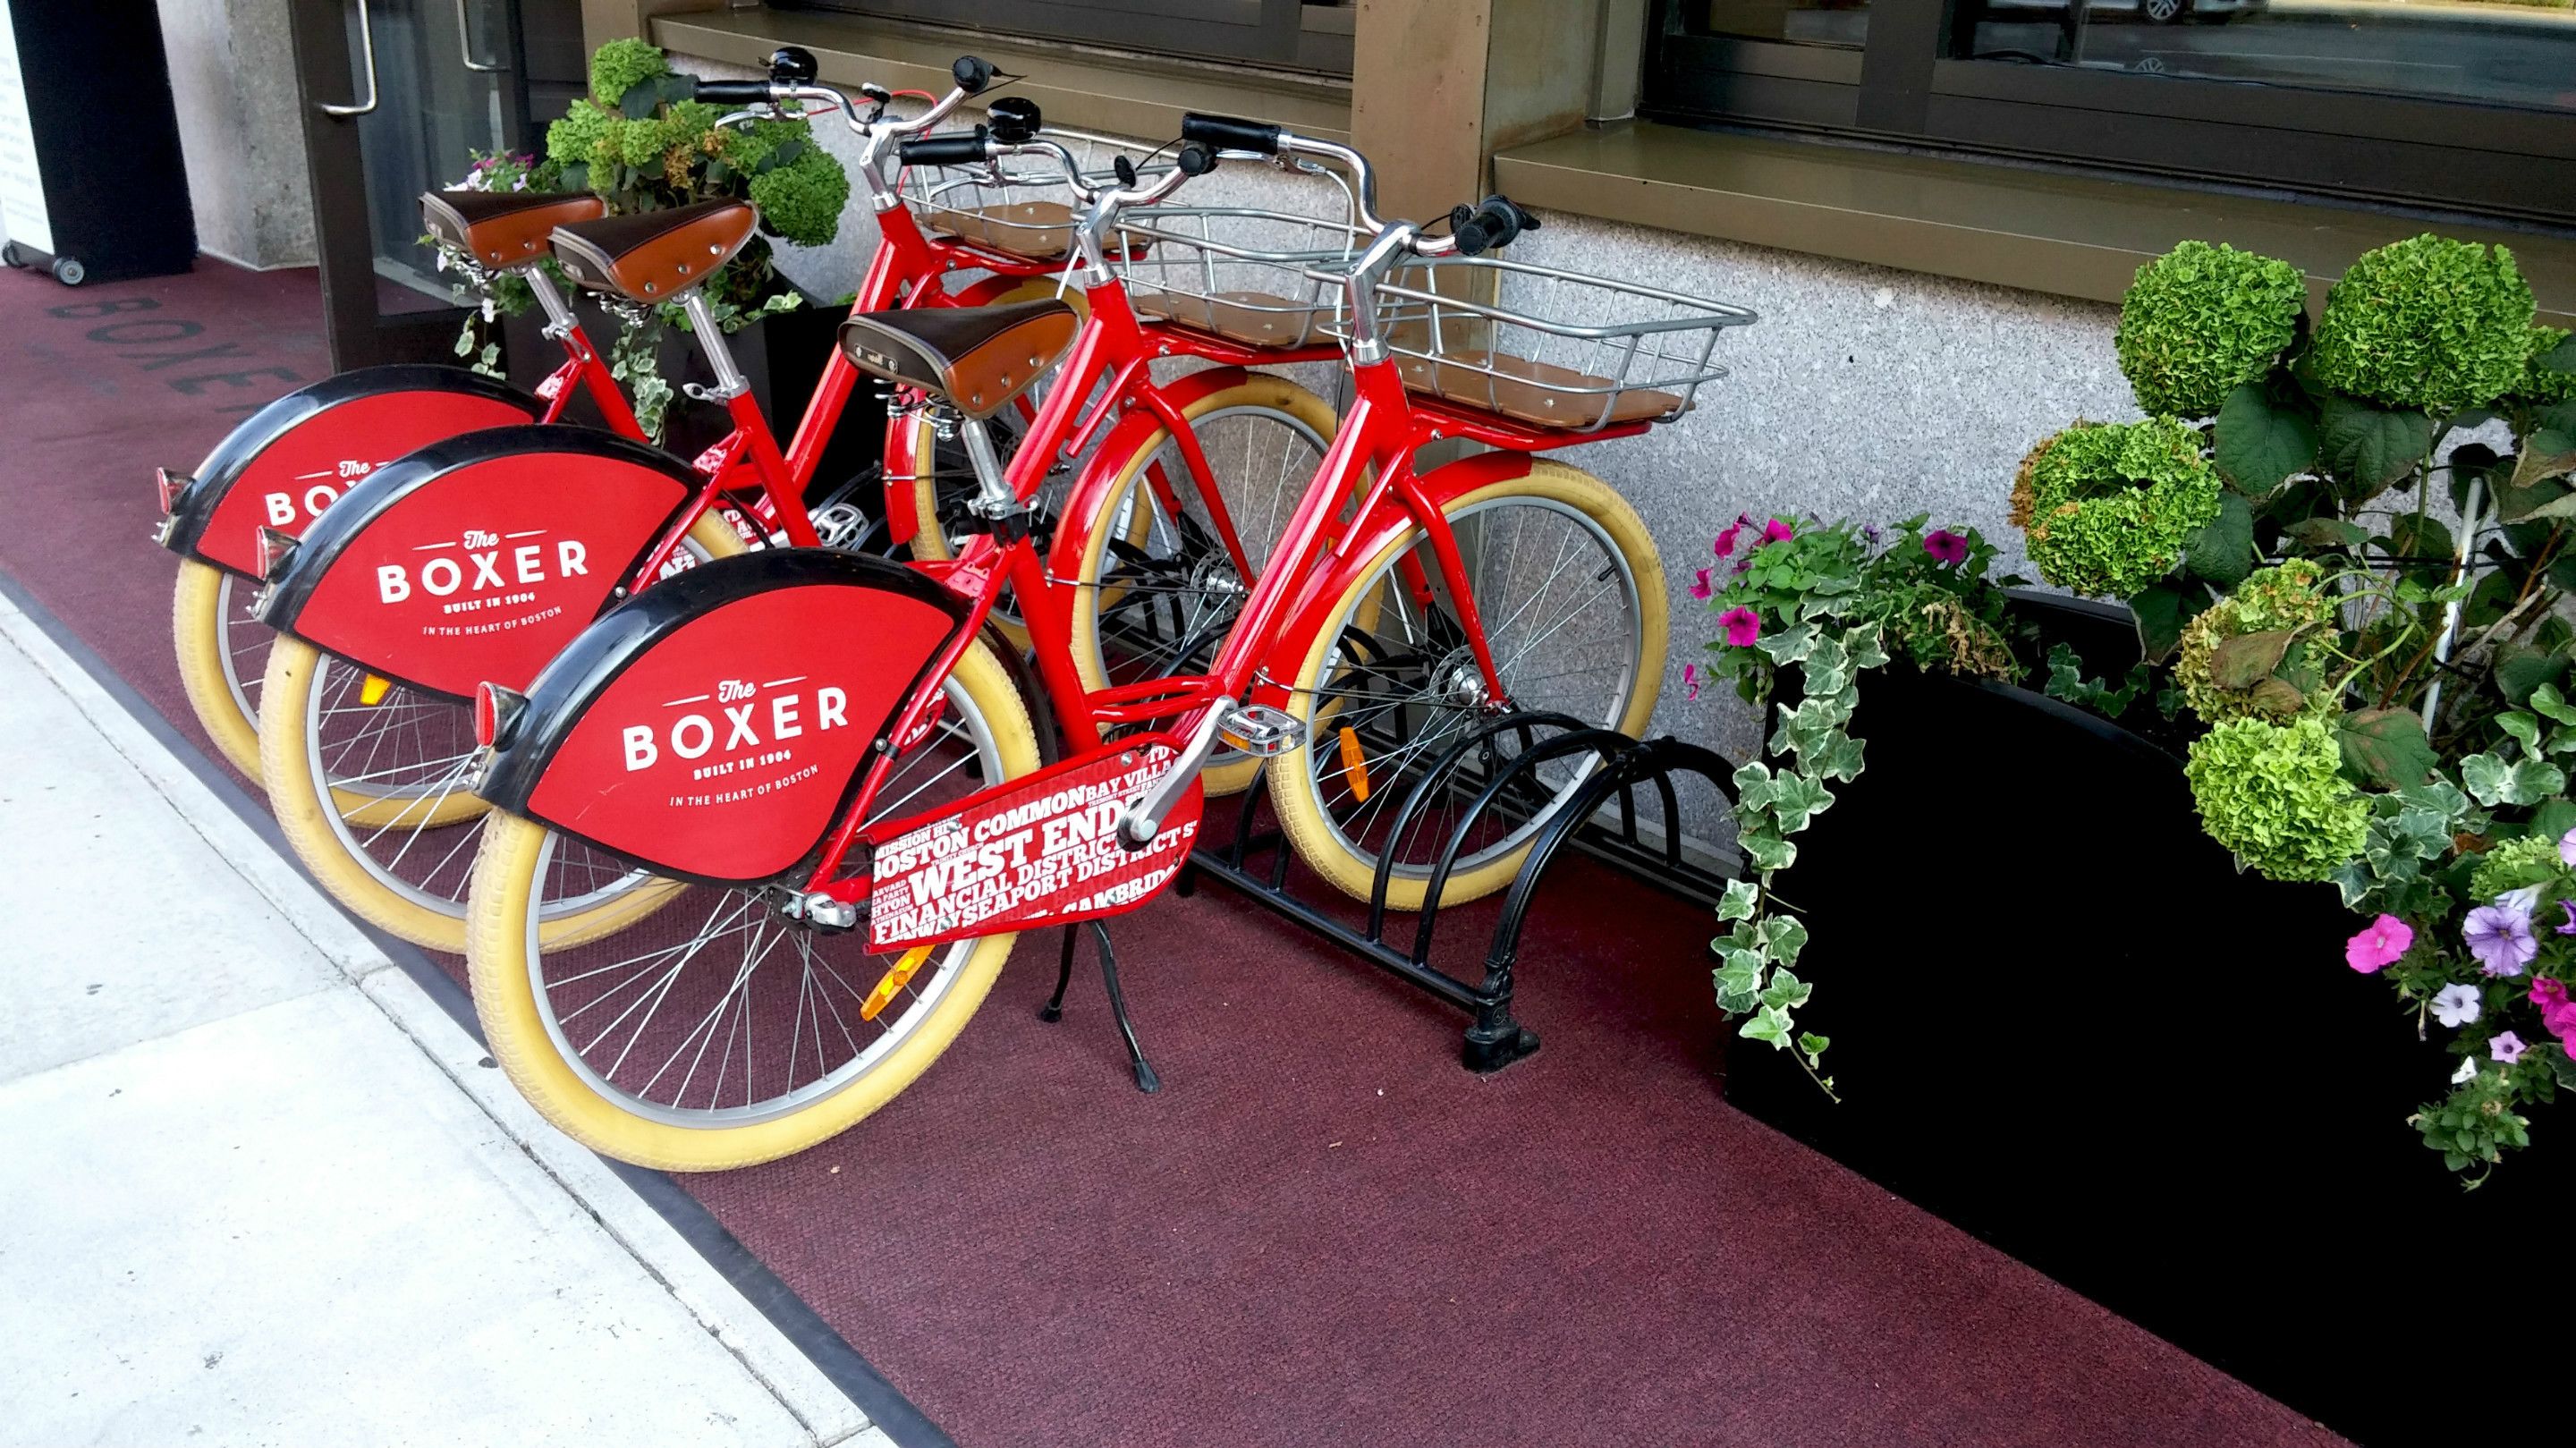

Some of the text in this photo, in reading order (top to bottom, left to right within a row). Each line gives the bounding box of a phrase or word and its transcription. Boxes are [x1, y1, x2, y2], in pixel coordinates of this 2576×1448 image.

[47, 298, 306, 414] BOXE
[339, 460, 370, 478] The
[265, 480, 357, 526] BO
[463, 530, 499, 550] The
[377, 540, 589, 605] BOXER
[423, 606, 562, 636] IN THE HEART OF BOSTON
[443, 592, 536, 614] BUILT IN 1904
[718, 680, 756, 703] The
[623, 687, 849, 772] BOXER
[670, 764, 818, 807] IN THE HEART OF BOSTON
[693, 749, 792, 780] BUILT IN 1904
[1085, 776, 1123, 802] BAY
[1123, 759, 1172, 787] VILLA
[974, 784, 1087, 843] COMMON
[908, 829, 1033, 906] WEST
[1042, 800, 1125, 857] END
[875, 872, 1013, 944] FINANCIAL
[962, 867, 1073, 927] SEAPORT
